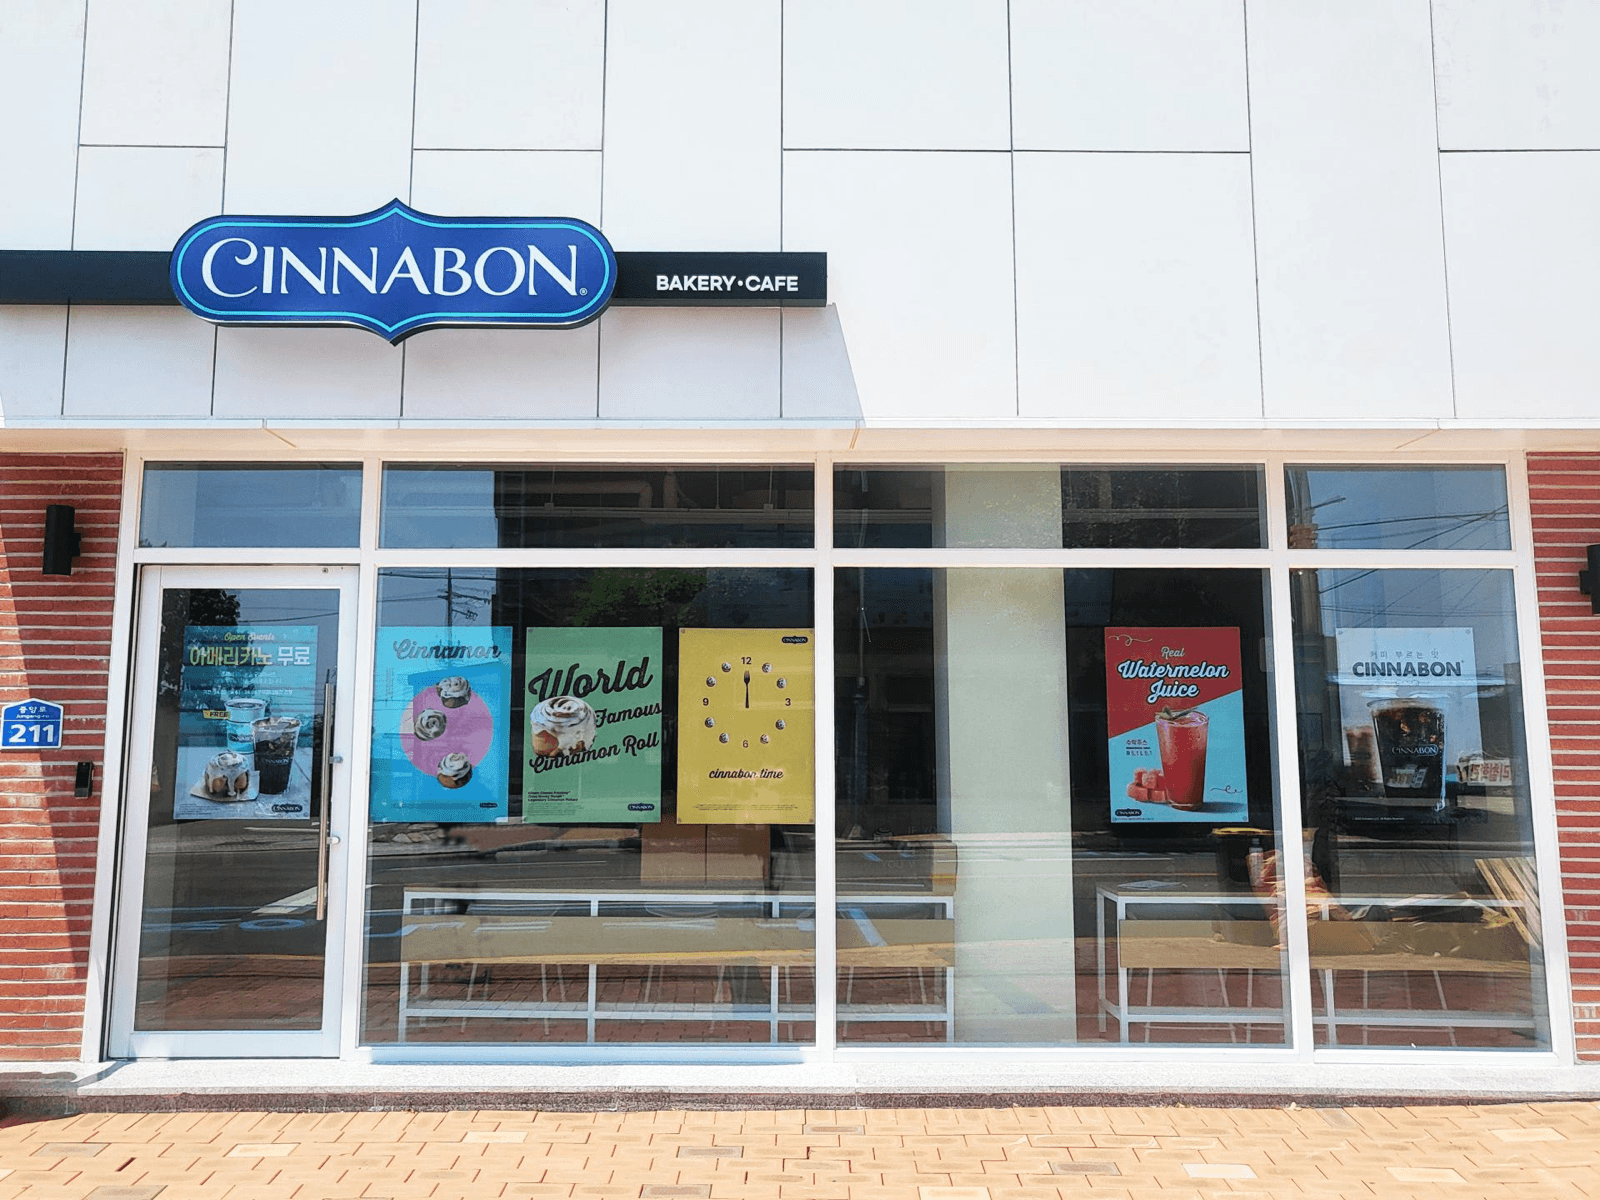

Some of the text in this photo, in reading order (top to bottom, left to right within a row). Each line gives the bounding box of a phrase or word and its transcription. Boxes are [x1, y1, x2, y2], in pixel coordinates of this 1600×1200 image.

[202, 238, 578, 298] CINNABON
[190, 646, 311, 667] 아메리카노 무료
[393, 639, 501, 660] Cinnamon
[1161, 646, 1186, 660] Real
[741, 656, 752, 665] 12
[1117, 659, 1230, 679] Watermelon
[1352, 662, 1462, 677] CINNABON
[528, 656, 653, 702] World
[1147, 679, 1200, 704] Juice
[702, 697, 709, 706] 9
[785, 697, 792, 706] 3
[594, 703, 662, 728] Famous
[9, 724, 54, 743] 211
[529, 732, 660, 773] Cinnamon Roll
[742, 740, 749, 748] 6
[760, 768, 784, 779] time
